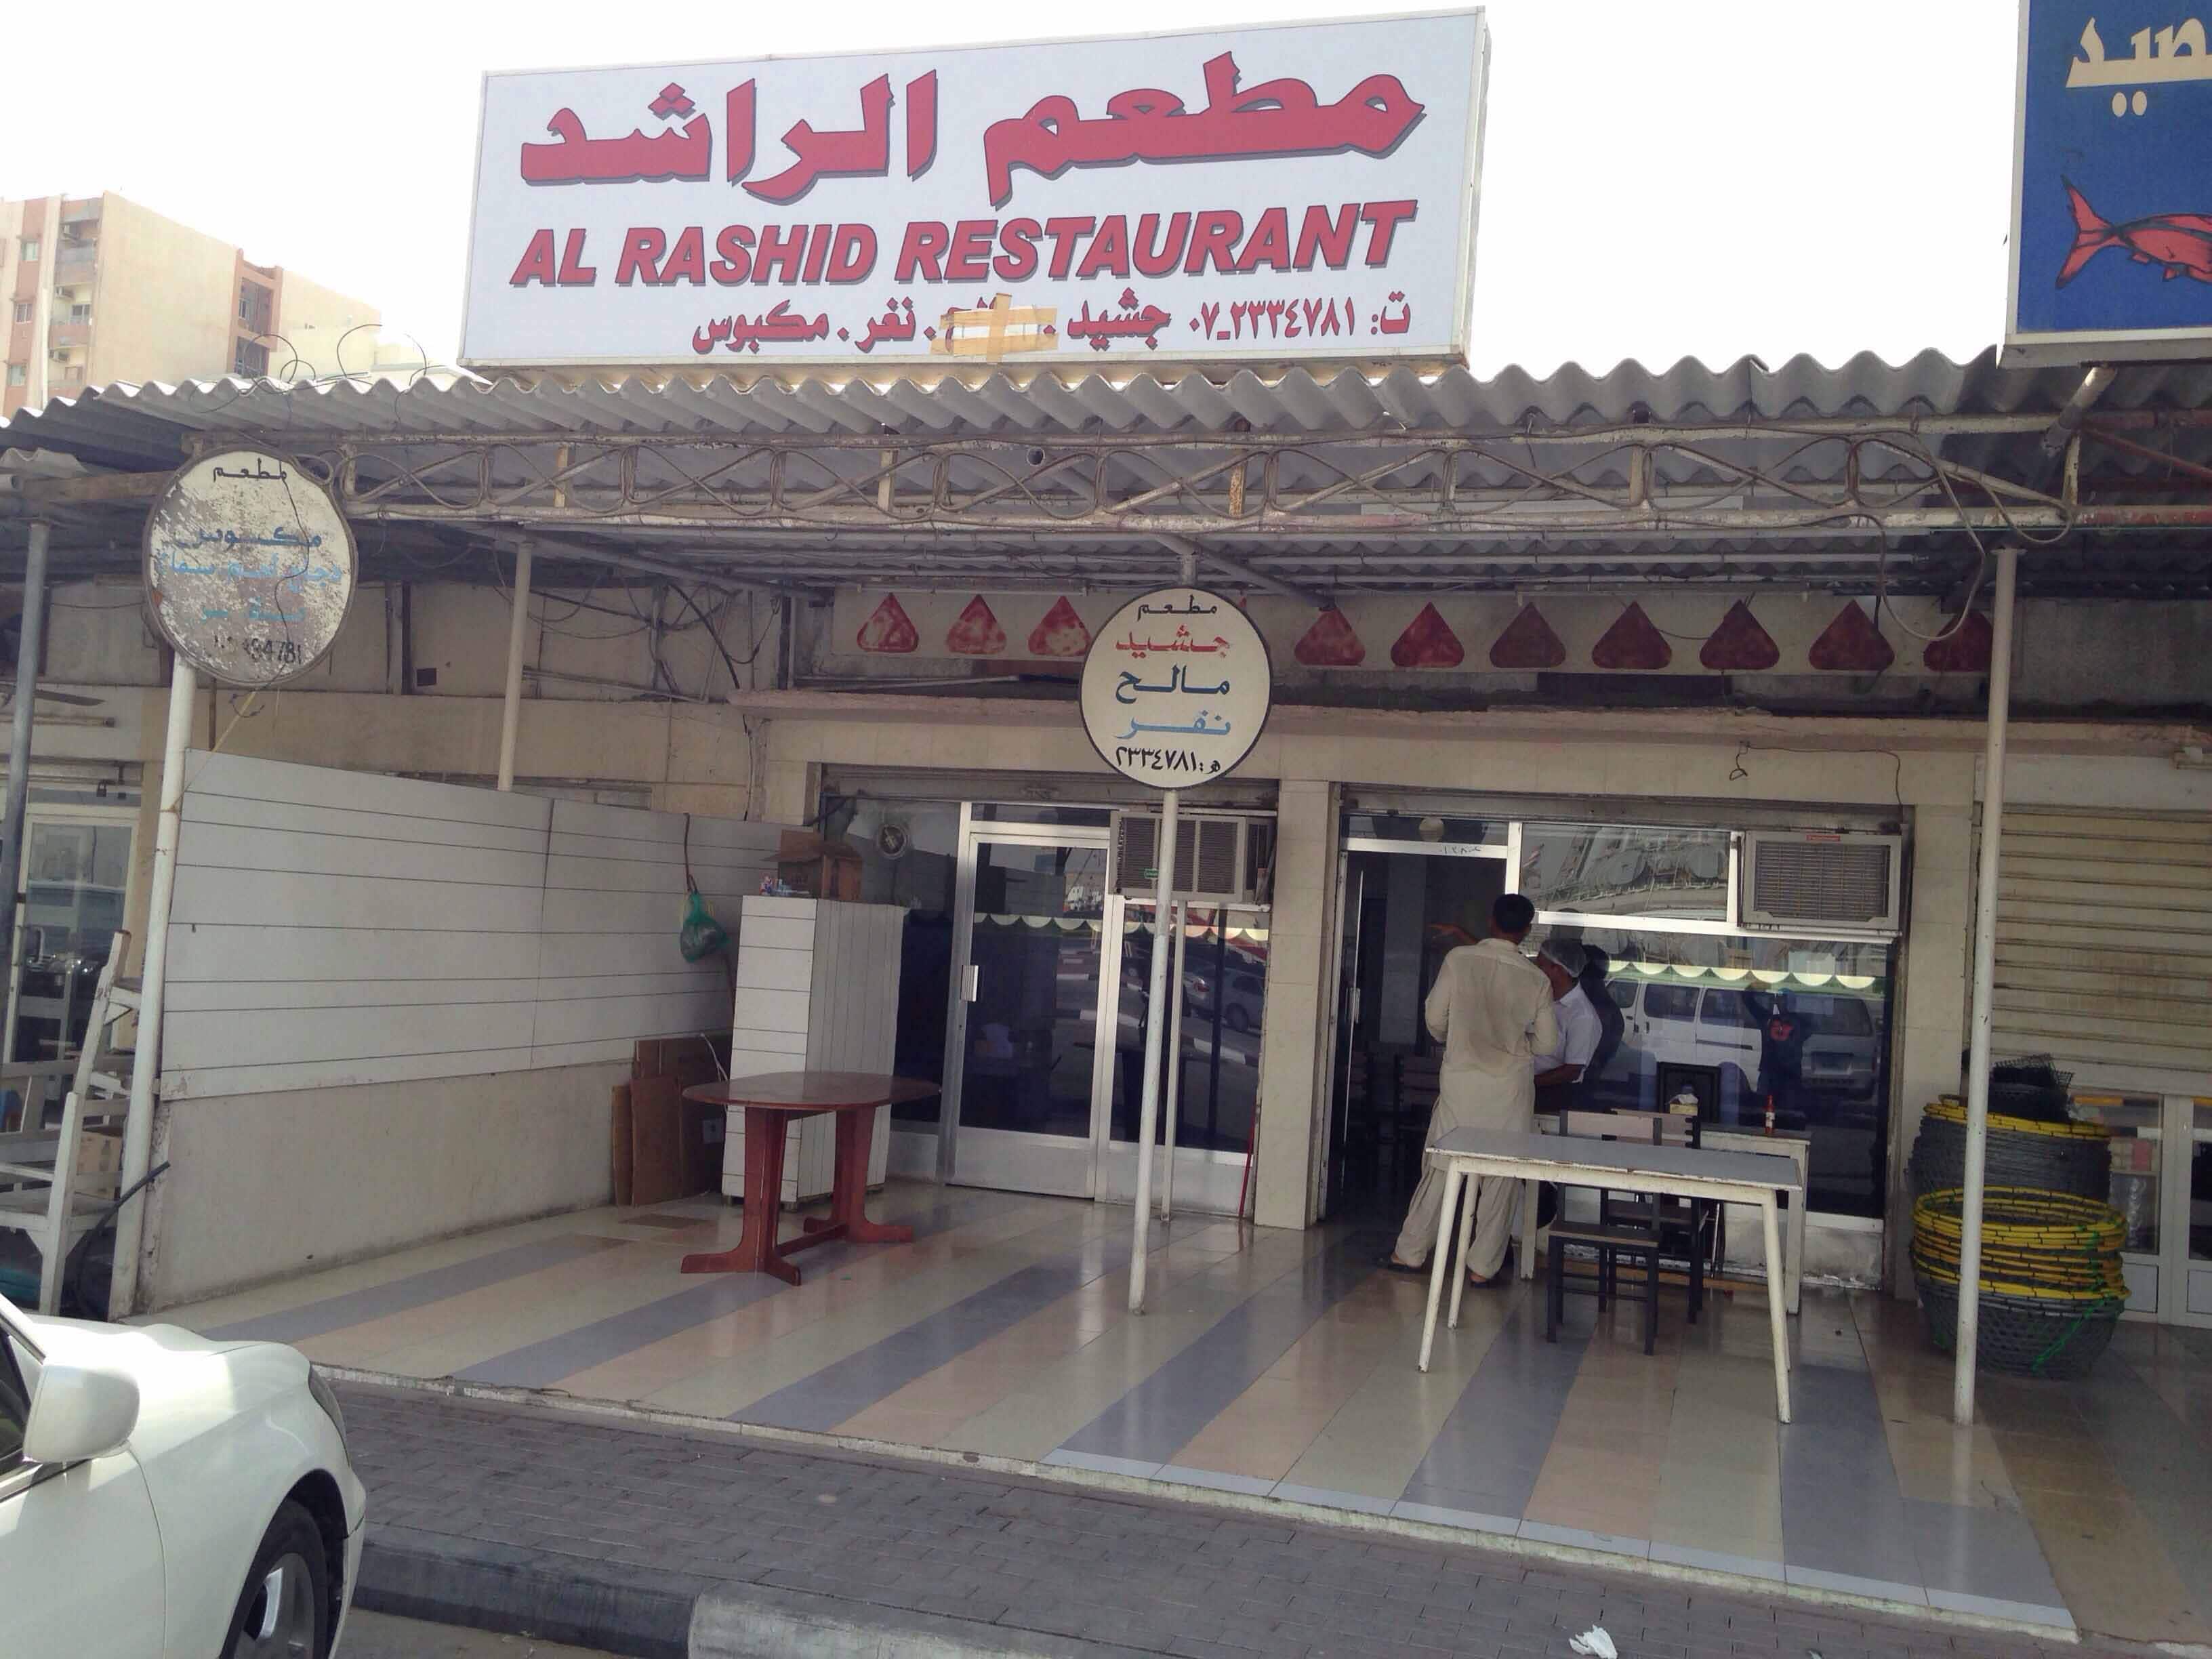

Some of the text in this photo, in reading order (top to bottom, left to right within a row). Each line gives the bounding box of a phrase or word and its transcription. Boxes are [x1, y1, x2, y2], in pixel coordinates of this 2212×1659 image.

[521, 51, 1426, 211] مطعم الراشد
[509, 199, 1418, 287] AL RASHID RESTAURANT
[692, 299, 830, 354] مكبوس
[1067, 287, 1171, 351] جشيد
[1136, 594, 1218, 621] مطعم
[1115, 623, 1229, 659] جشيد
[1115, 663, 1231, 704] مالح
[1113, 710, 1231, 739] نفر
